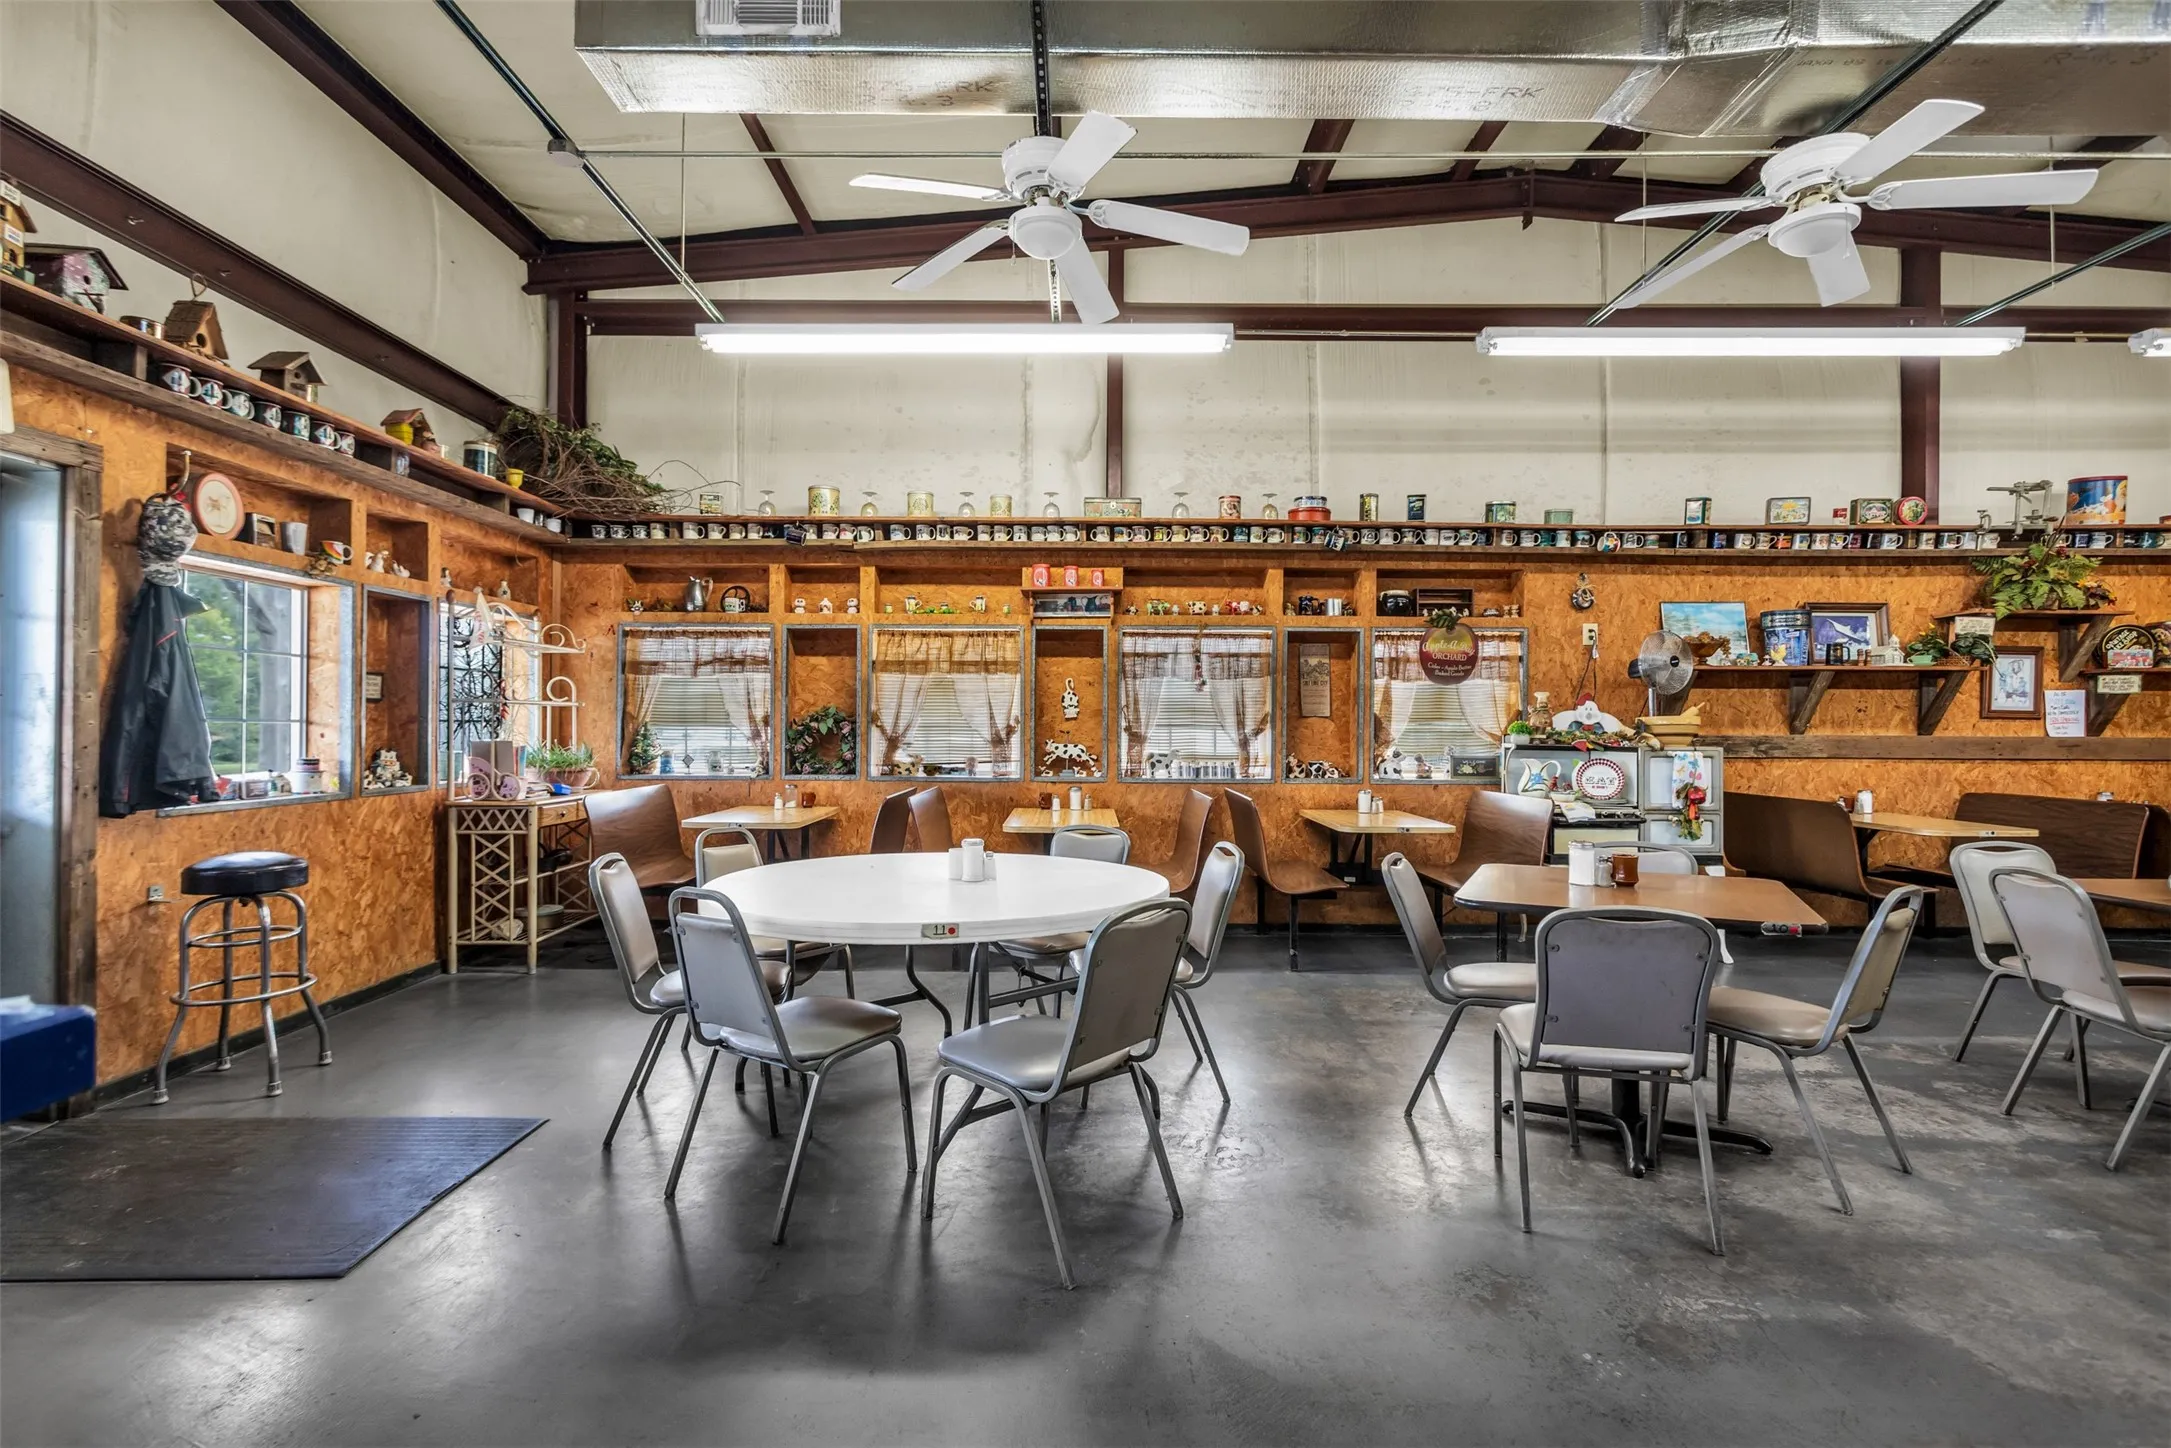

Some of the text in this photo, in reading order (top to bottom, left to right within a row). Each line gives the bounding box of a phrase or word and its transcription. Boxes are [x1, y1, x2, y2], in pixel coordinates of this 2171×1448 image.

[1432, 652, 1468, 661] ORCHARD
[1585, 776, 1617, 786] EAT
[933, 924, 947, 936] 11
[1772, 923, 1788, 933] 10
